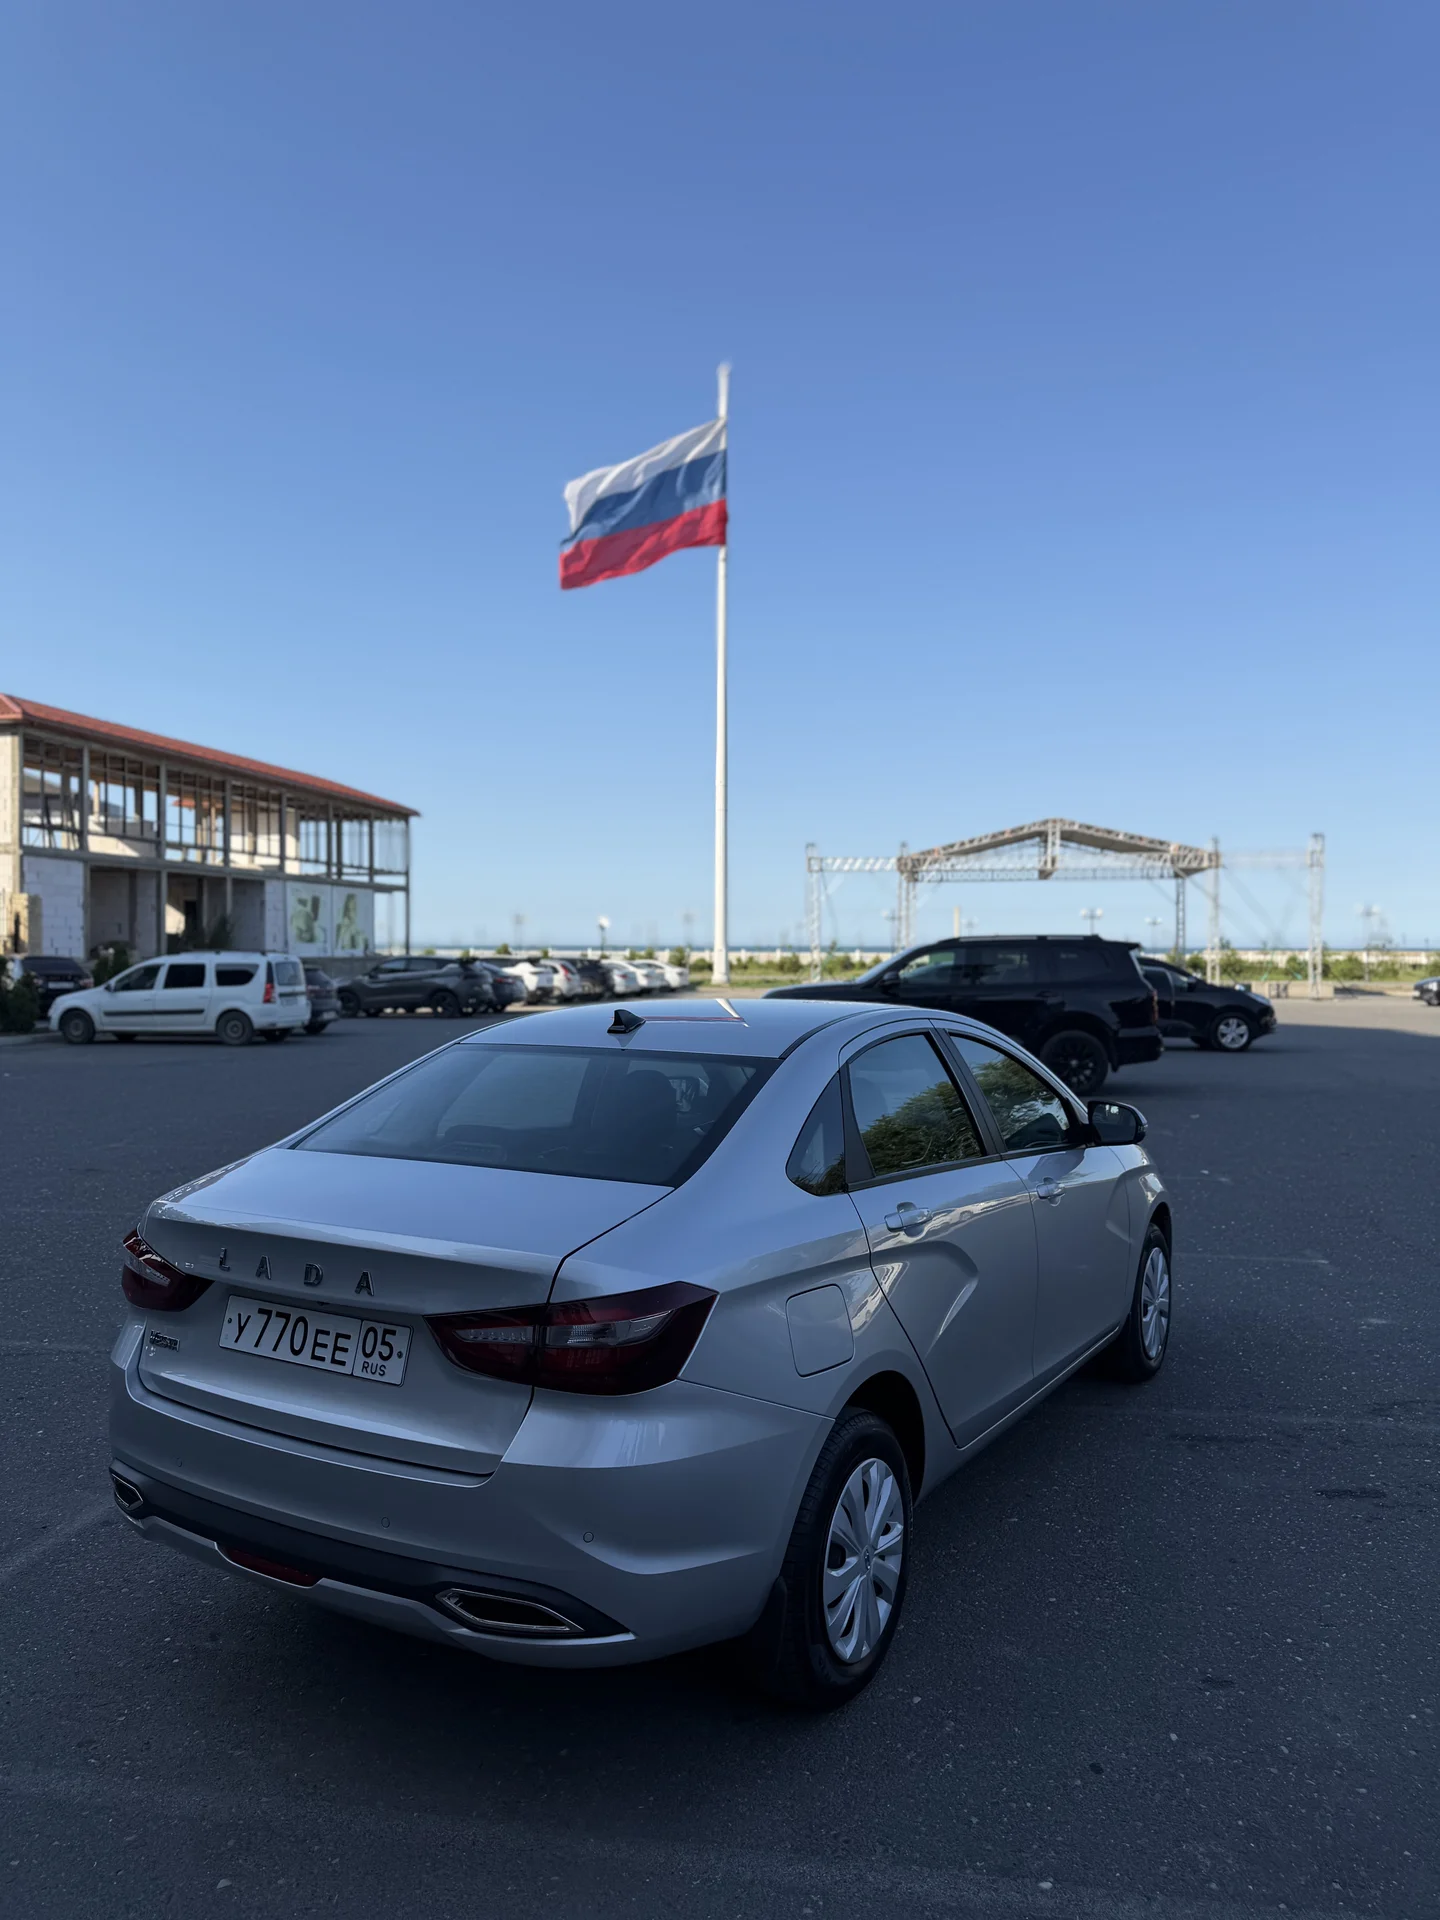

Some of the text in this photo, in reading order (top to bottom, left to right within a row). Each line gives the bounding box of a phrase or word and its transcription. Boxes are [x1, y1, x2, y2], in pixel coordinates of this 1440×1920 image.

[219, 1247, 375, 1296] LADA
[362, 1326, 397, 1361] 05
[361, 1361, 387, 1377] RUS
